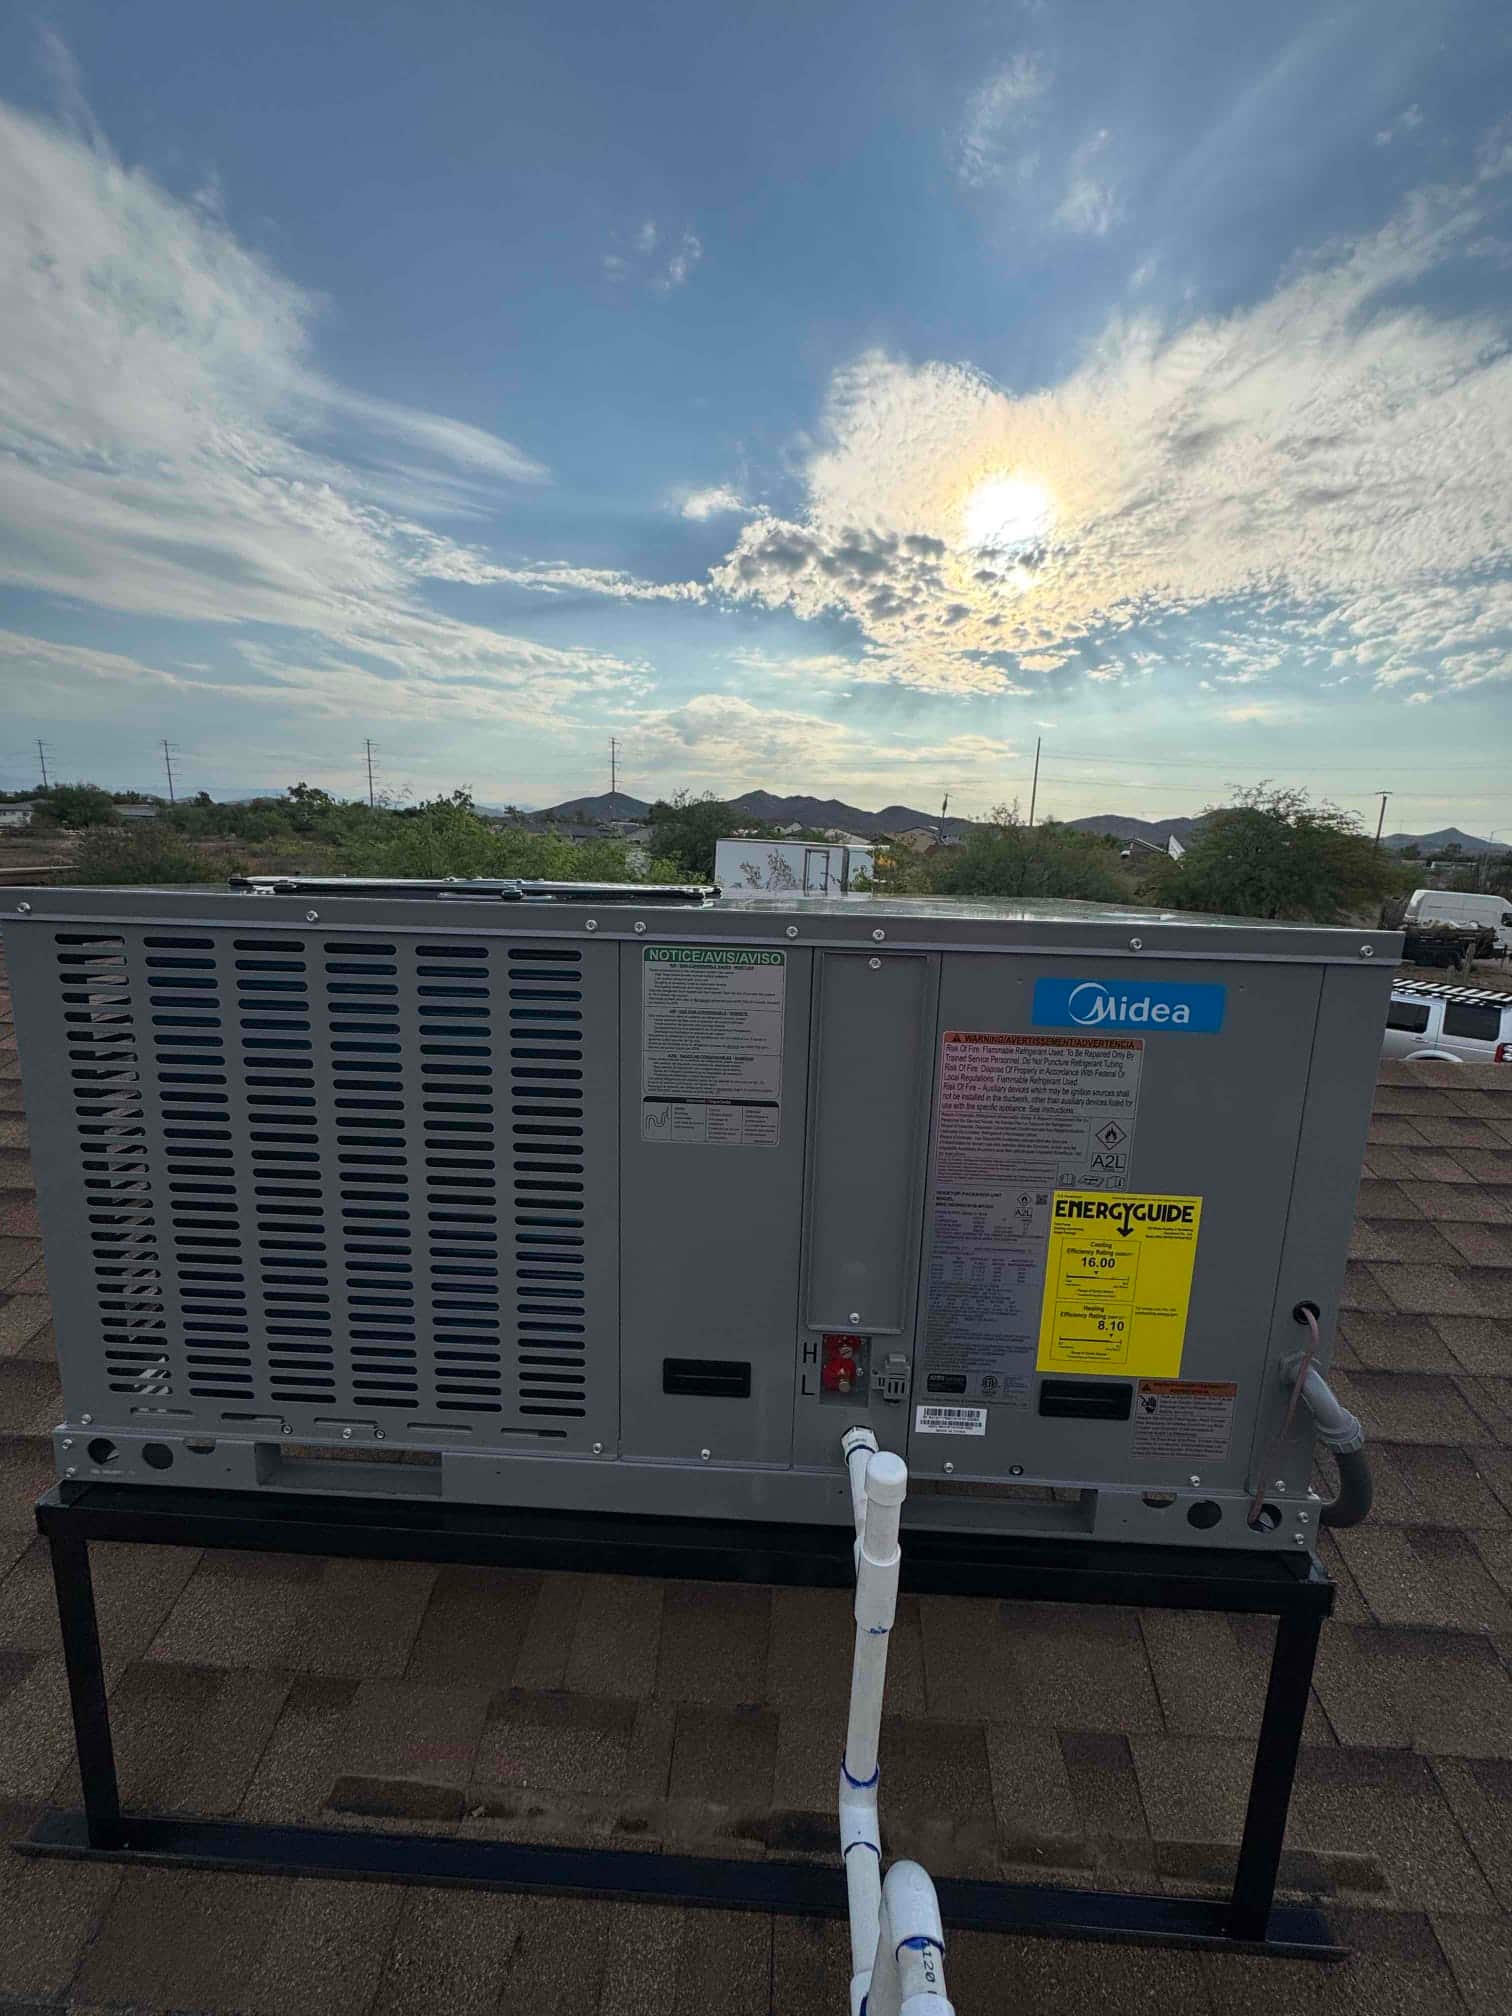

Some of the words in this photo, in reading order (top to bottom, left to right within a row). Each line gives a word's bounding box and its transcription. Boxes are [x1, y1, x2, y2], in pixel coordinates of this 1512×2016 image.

[649, 950, 781, 965] NOTICE/AVIS/AVISO
[1071, 987, 1190, 1024] Midea
[1092, 1154, 1125, 1169] A2L
[1055, 1200, 1195, 1224] ENERGYGUIDE
[1066, 1248, 1095, 1256] Efficiency
[1090, 1241, 1113, 1250] Cooling
[1081, 1257, 1116, 1268] 16.00
[1088, 1312, 1107, 1320] Rating
[1098, 1320, 1124, 1332] 8.10
[802, 1342, 818, 1364] H
[801, 1375, 816, 1396] L
